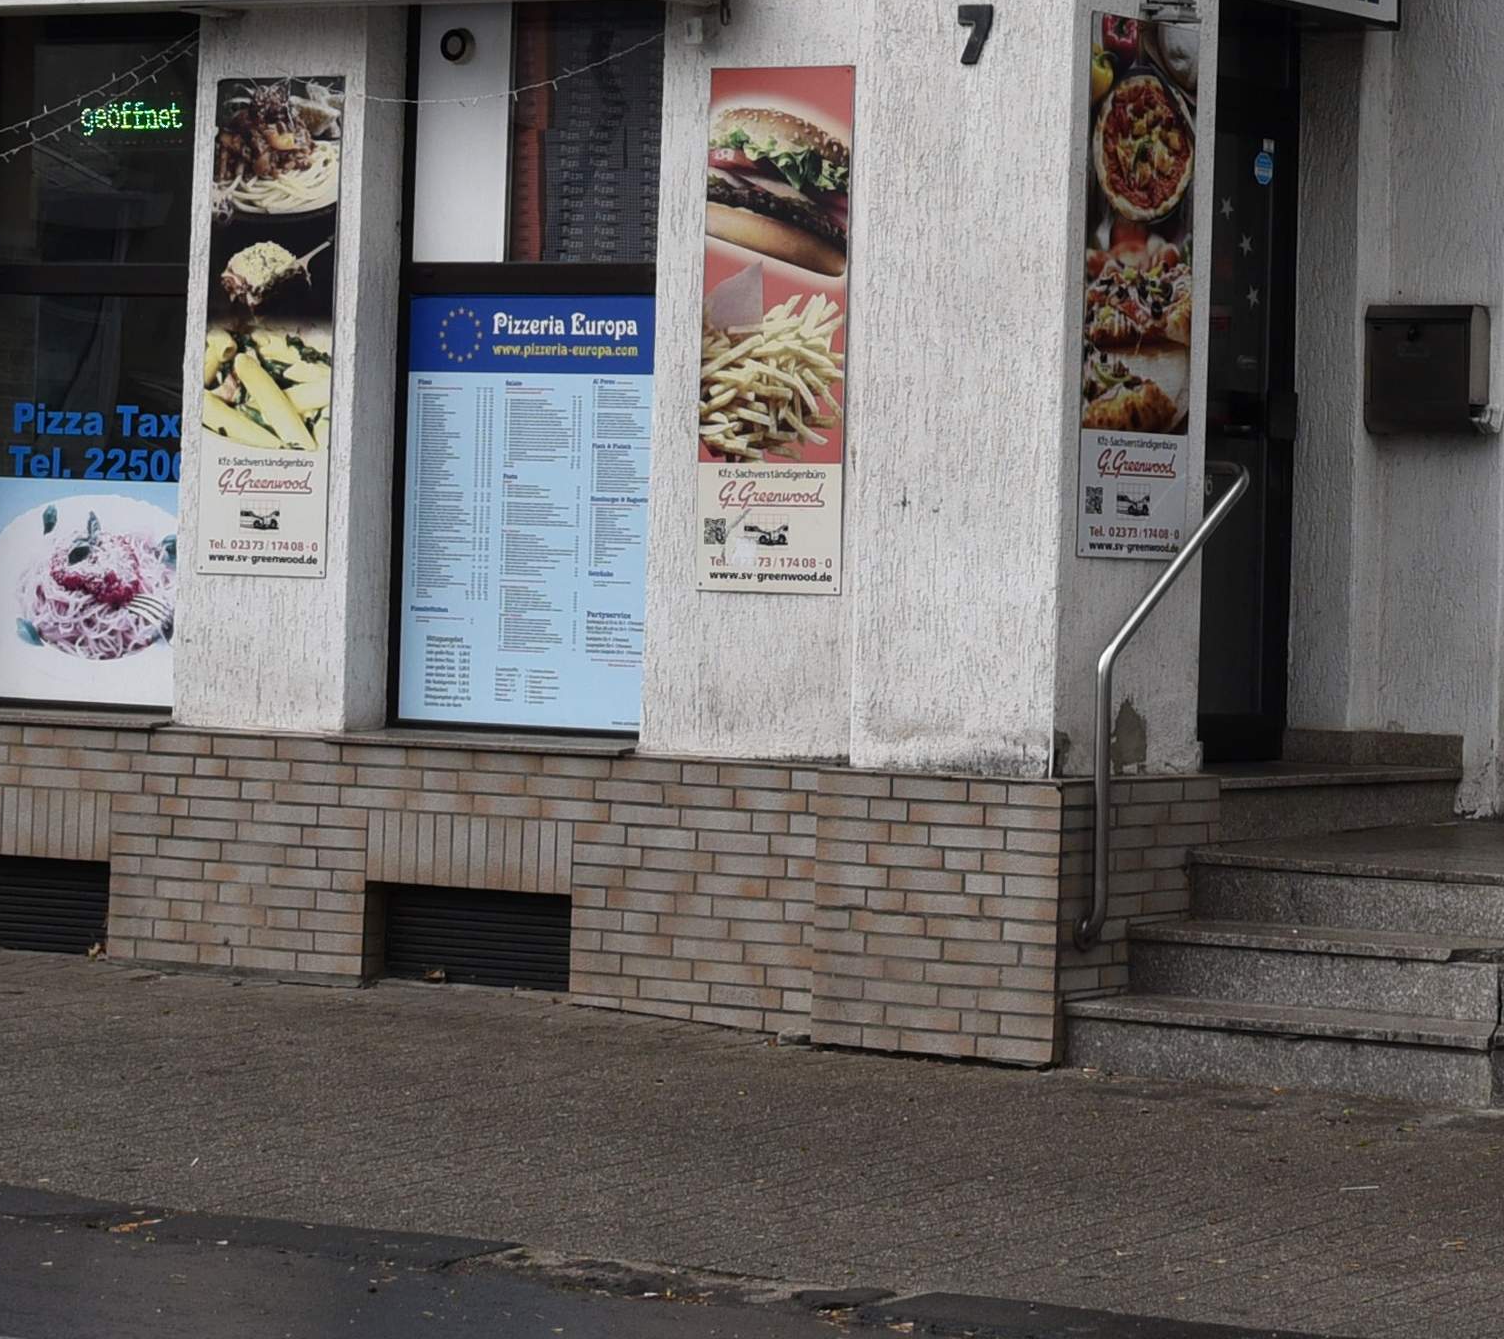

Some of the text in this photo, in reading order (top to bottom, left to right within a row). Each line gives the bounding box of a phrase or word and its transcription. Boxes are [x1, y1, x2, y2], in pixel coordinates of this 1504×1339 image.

[957, 3, 994, 65] 7
[80, 102, 184, 136] geöffnet
[492, 312, 638, 341] Pizzeria Europa
[492, 343, 639, 359] www.pizzeria-europa.com
[12, 402, 181, 438] Pizza Tax
[8, 445, 72, 480] Tel.
[1112, 449, 1176, 478] Greenwood
[235, 468, 313, 495] Greenwood
[718, 468, 826, 481] Kfz-Sachverständigenbüro
[738, 481, 825, 509] Greenwood
[1089, 526, 1105, 537] Tel.
[209, 539, 226, 550] Tel.
[1088, 542, 1179, 553] www.sv-greenwood.de
[208, 554, 318, 565] www.sv-greenwood.de
[709, 556, 729, 567] Tel.
[709, 571, 833, 583] www.sv-greenwood.de
